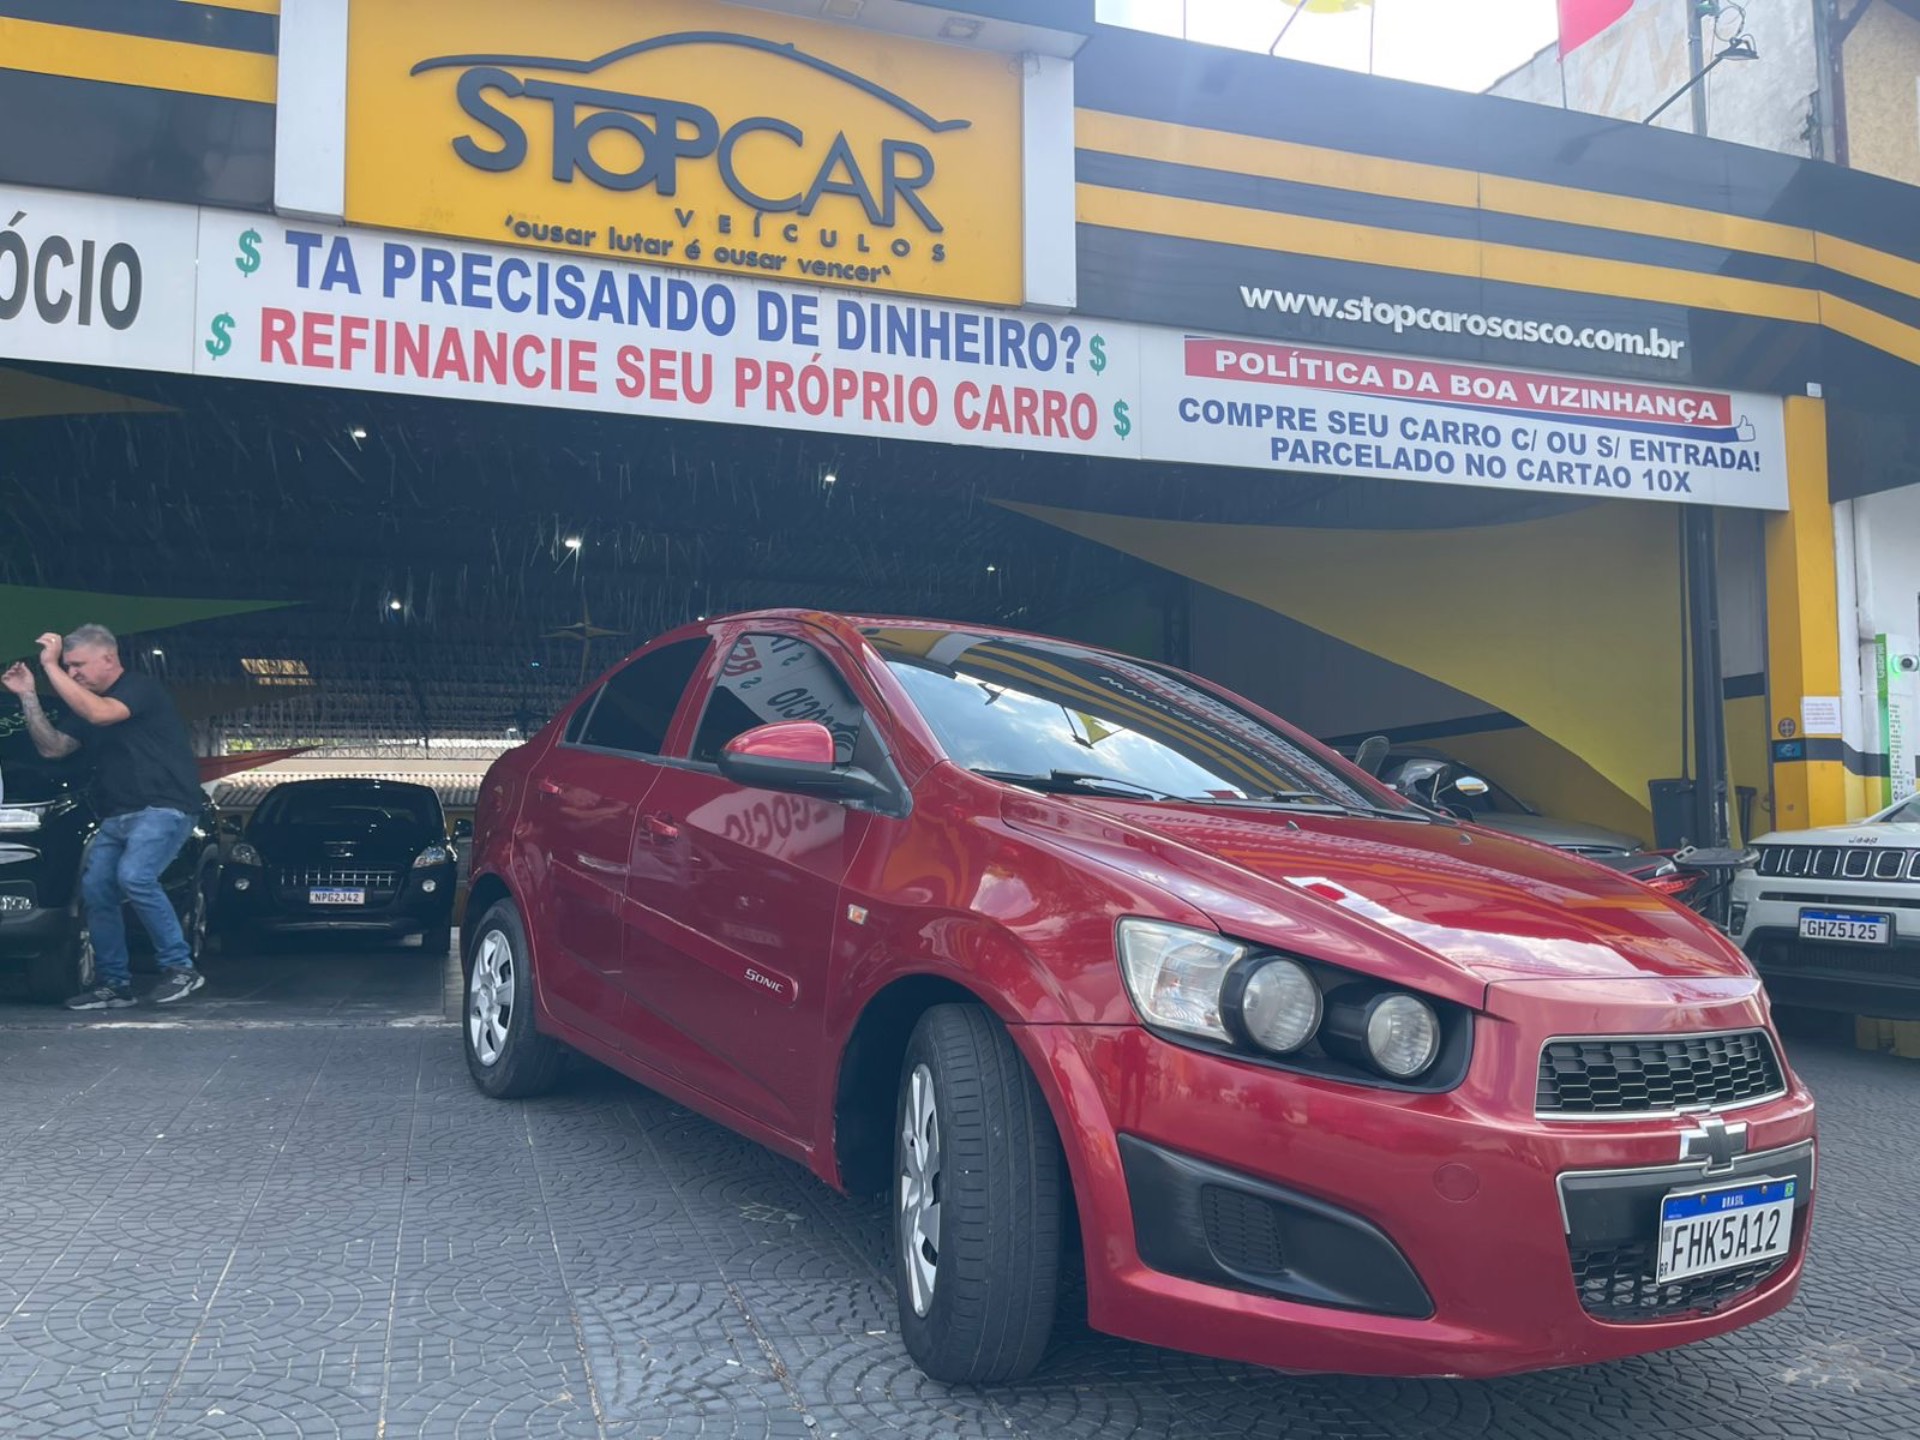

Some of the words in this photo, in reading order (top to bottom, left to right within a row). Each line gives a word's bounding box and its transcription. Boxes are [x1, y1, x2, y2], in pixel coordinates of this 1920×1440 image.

[453, 66, 943, 233] STOPCAR
[608, 226, 674, 257] lutar
[685, 238, 701, 260] é
[714, 244, 786, 271] ousar
[675, 207, 946, 263] VEÍCULOS
[285, 229, 362, 295] TA
[382, 241, 736, 337] PRECISANDO
[757, 289, 820, 347] DE
[837, 300, 1082, 374] DINHEIRO?
[1239, 283, 1686, 362] www.stopcarosasco.com.br
[260, 306, 598, 394] REFINANCIE
[615, 344, 714, 405] SEU
[735, 352, 938, 427] PRÓPRIO
[953, 379, 1099, 441] CARRO
[1215, 349, 1384, 388] POLÍTICA
[1392, 367, 1440, 395] DA
[1450, 374, 1519, 403] BOA
[1527, 381, 1719, 424] VIZINHANÇA
[1179, 397, 1319, 434] COMPRE
[1327, 407, 1390, 439] SEU
[1402, 415, 1501, 449] CARRO
[1511, 427, 1539, 453] C/
[1546, 430, 1587, 457] OU
[1596, 435, 1622, 462] S/
[1629, 440, 1761, 473] ENTRADA!
[1271, 436, 1454, 475] PARCELADO
[1464, 452, 1507, 480] NO
[1516, 457, 1632, 490] CARTAO
[1642, 468, 1693, 494] 10X
[744, 967, 784, 994] SONIC
[1671, 1207, 1780, 1272] FHK5A12
